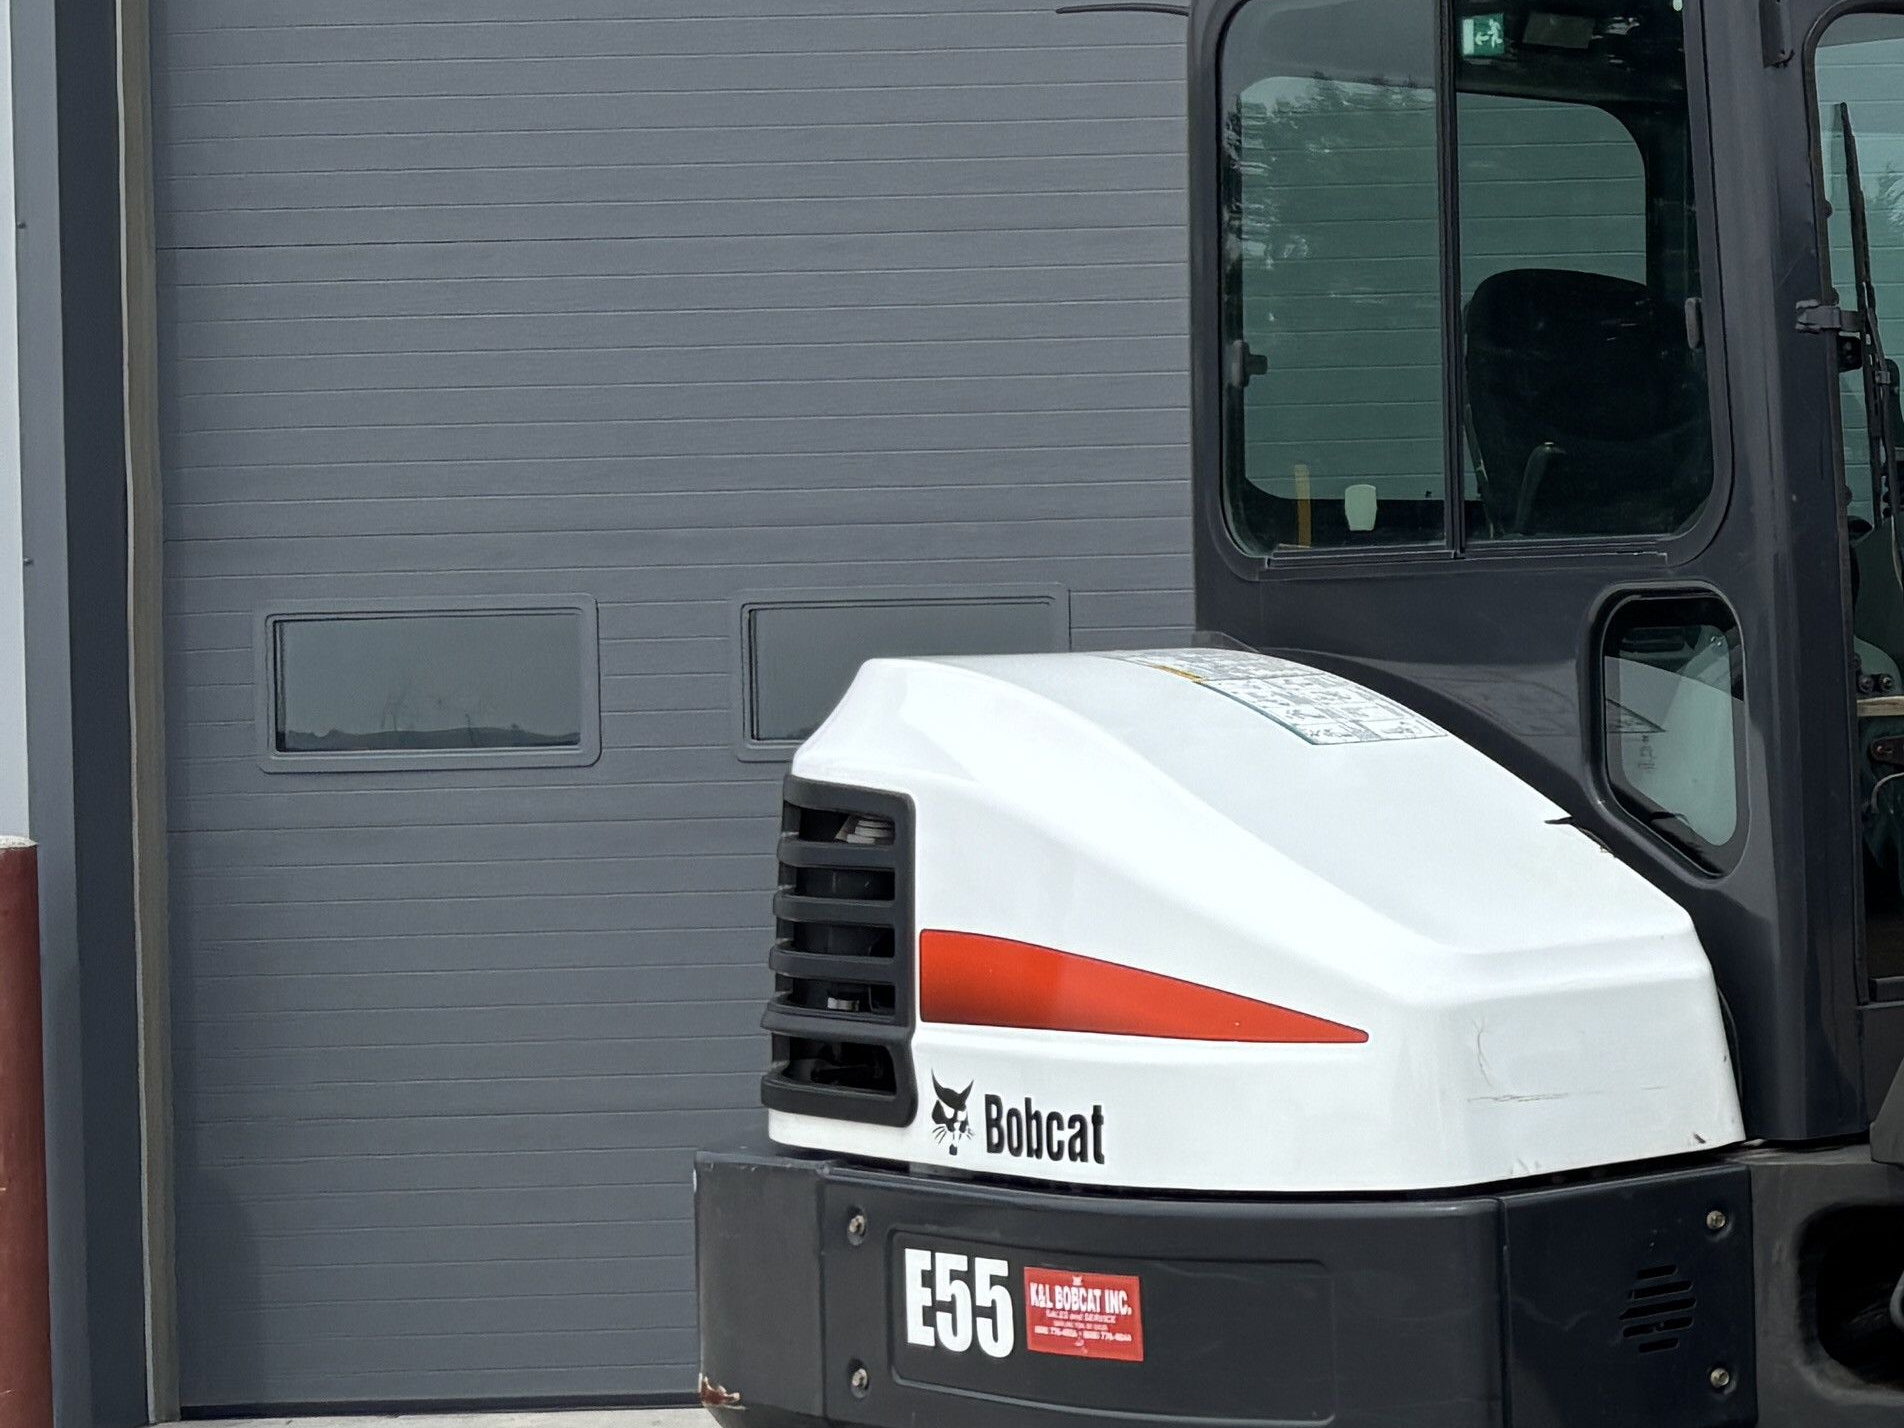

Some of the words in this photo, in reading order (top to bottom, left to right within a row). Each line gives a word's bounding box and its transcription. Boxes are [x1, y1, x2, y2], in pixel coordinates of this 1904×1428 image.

[984, 1093, 1105, 1165] Bobcat
[905, 1248, 1015, 1358] E55
[1030, 1282, 1054, 1309] K&L
[1054, 1284, 1102, 1313] BOBCAT
[1104, 1289, 1133, 1315] INC.
